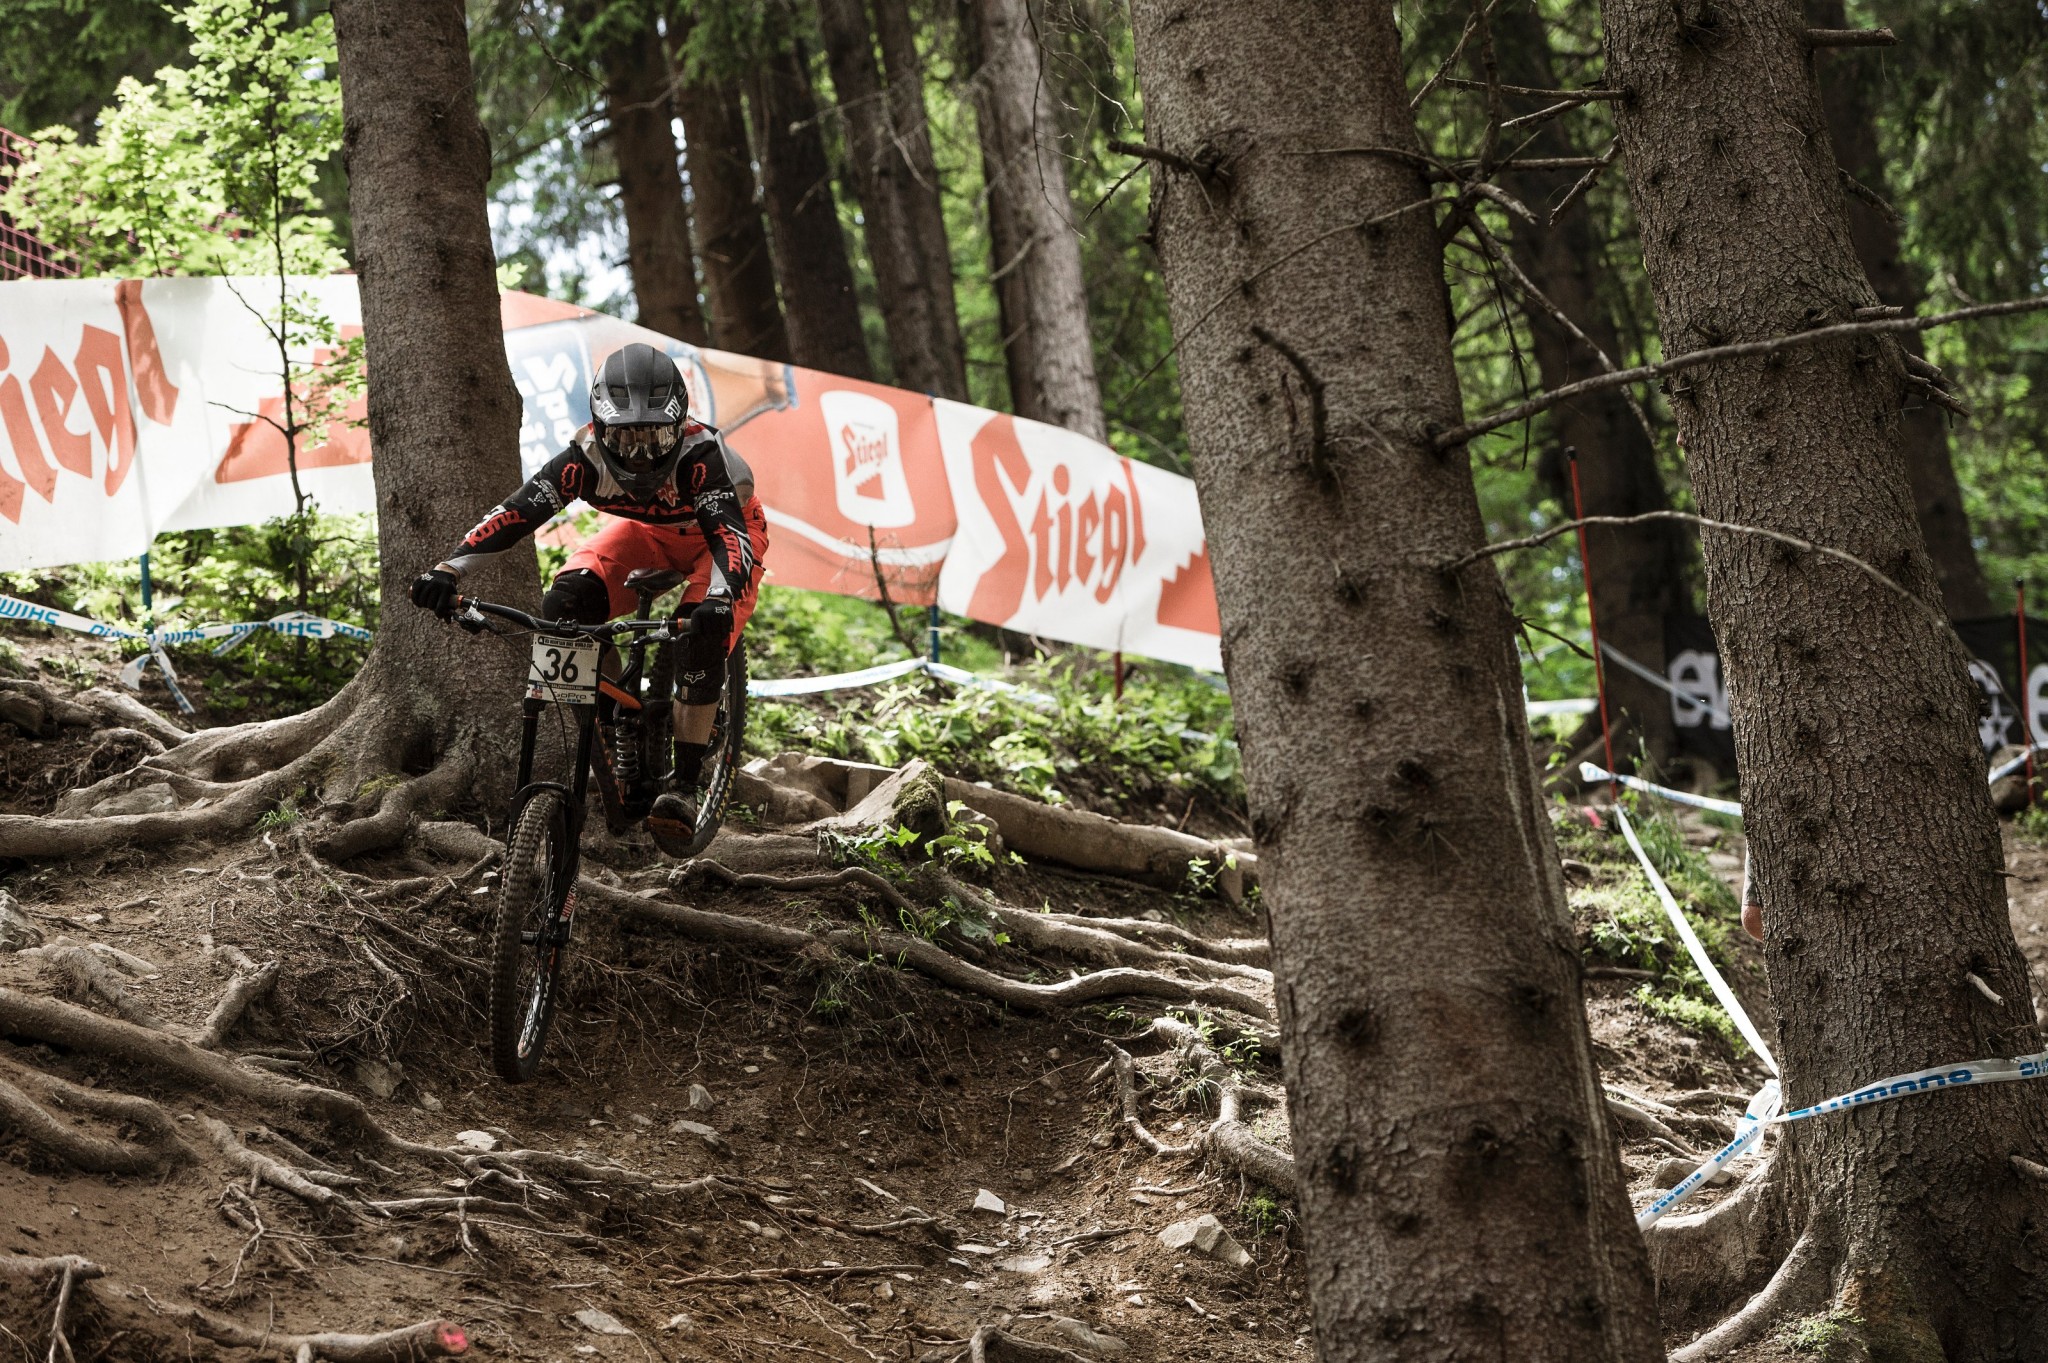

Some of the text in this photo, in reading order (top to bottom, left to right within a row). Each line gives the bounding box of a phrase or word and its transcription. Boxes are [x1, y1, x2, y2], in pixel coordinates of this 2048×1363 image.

[0, 279, 179, 525] iegl
[599, 399, 621, 422] FOX
[664, 395, 683, 422] FOX
[842, 424, 888, 477] Stiegl
[966, 412, 1147, 626] Stiegl
[544, 648, 579, 683] 36
